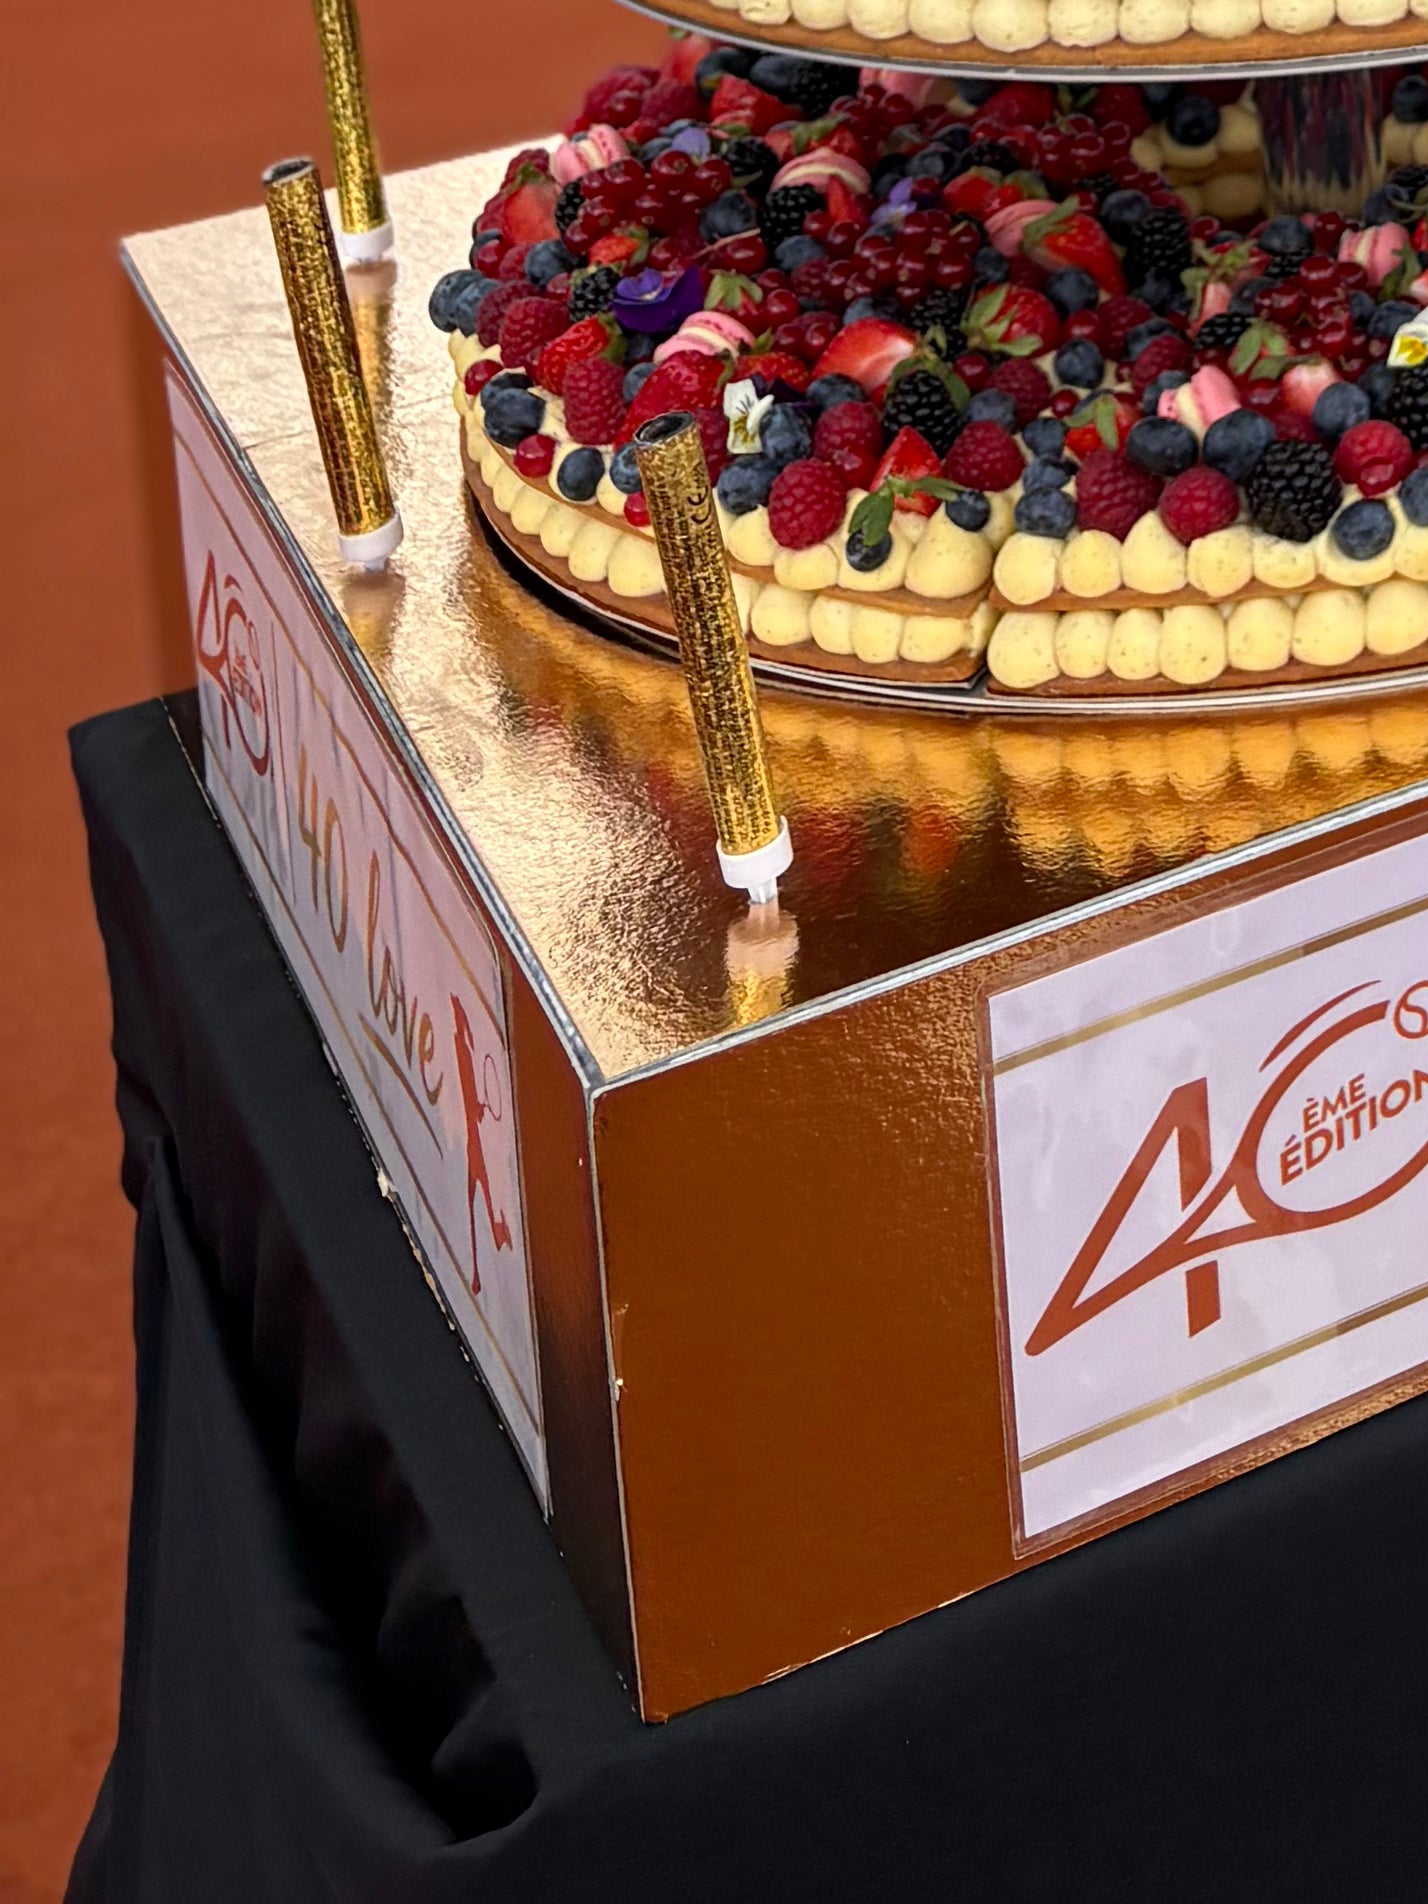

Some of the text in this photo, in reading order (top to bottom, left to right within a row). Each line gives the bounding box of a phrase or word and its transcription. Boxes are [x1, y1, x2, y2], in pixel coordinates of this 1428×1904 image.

[298, 745, 444, 1107] 40 love
[1303, 1073, 1366, 1133] ÈME
